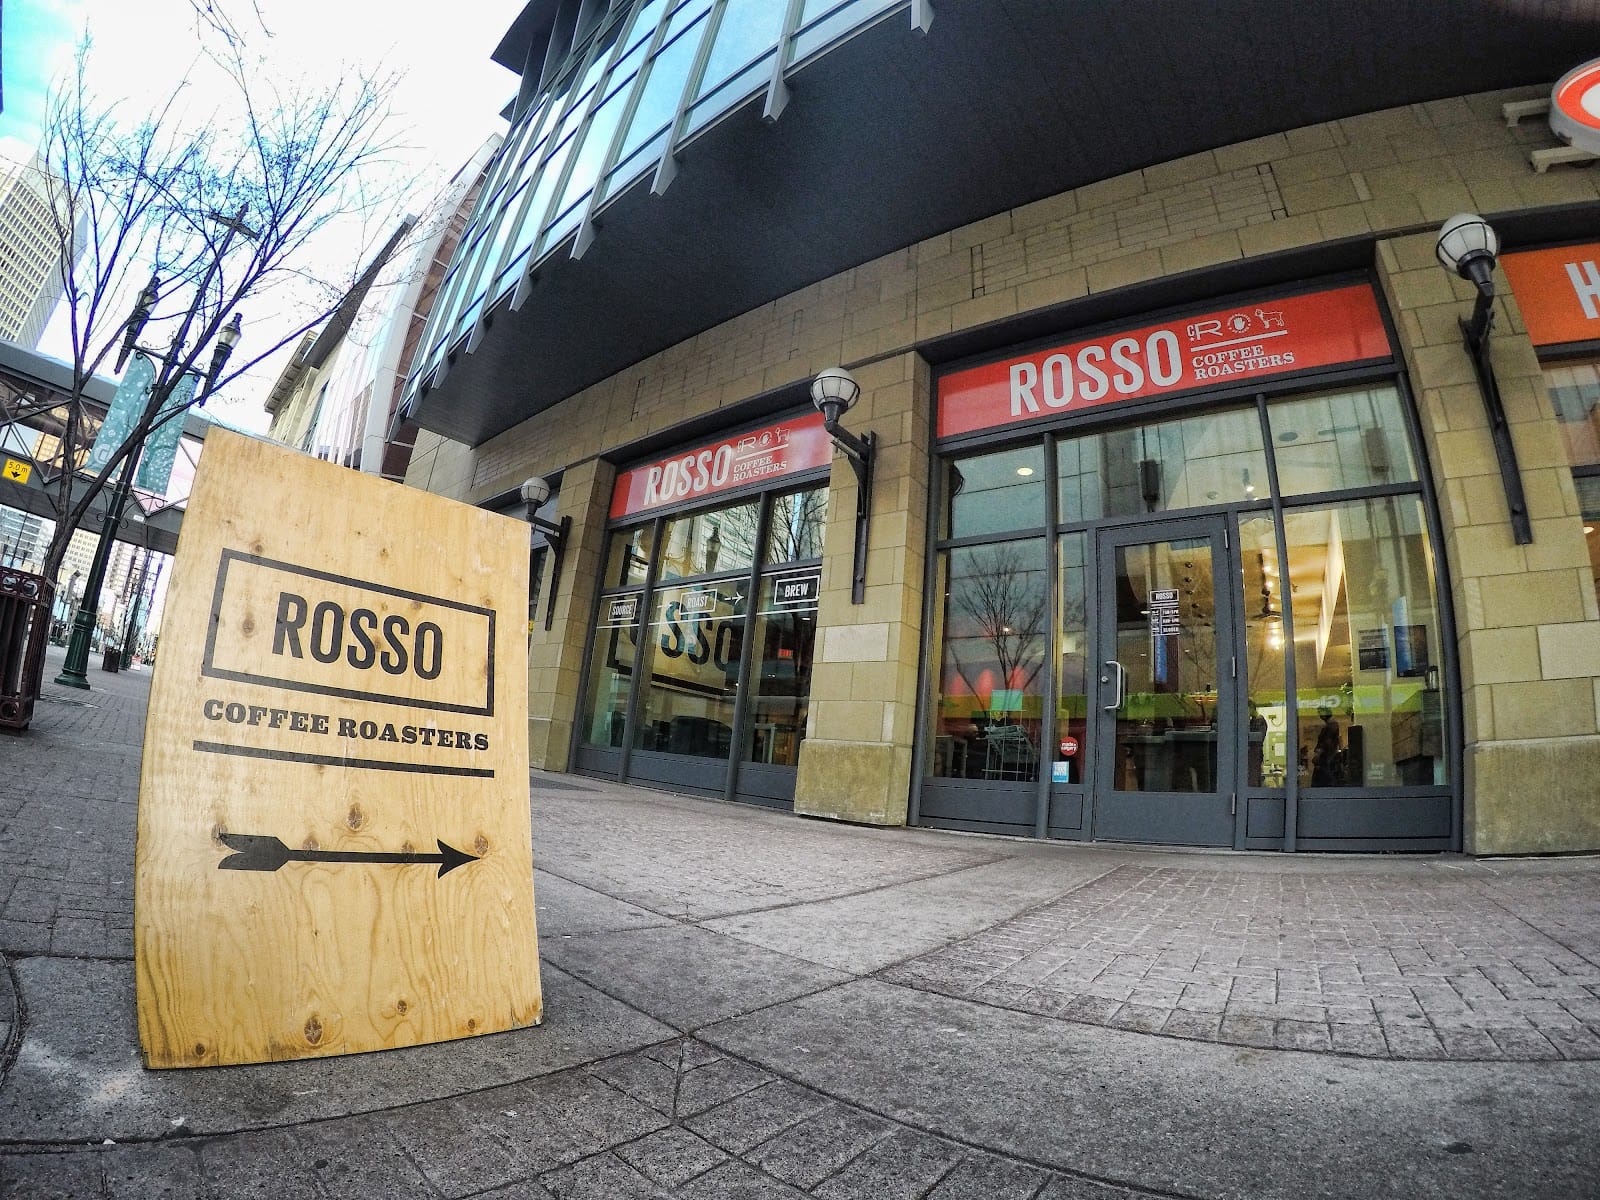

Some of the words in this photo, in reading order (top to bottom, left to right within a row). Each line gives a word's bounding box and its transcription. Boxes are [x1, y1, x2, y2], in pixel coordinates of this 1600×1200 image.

[1192, 345, 1264, 368] COFFEE
[1194, 352, 1295, 380] ROASTERS
[1010, 330, 1183, 416] ROSSO
[643, 444, 732, 505] ROSSO
[733, 461, 787, 481] ROASTERS
[734, 456, 773, 473] COFFEE
[686, 595, 709, 608] ROAST
[784, 583, 809, 597] BREW
[611, 604, 634, 616] SOURCE
[272, 592, 443, 680] ROSSO
[203, 699, 329, 735] COFFEE
[338, 718, 489, 751] ROASTERS
